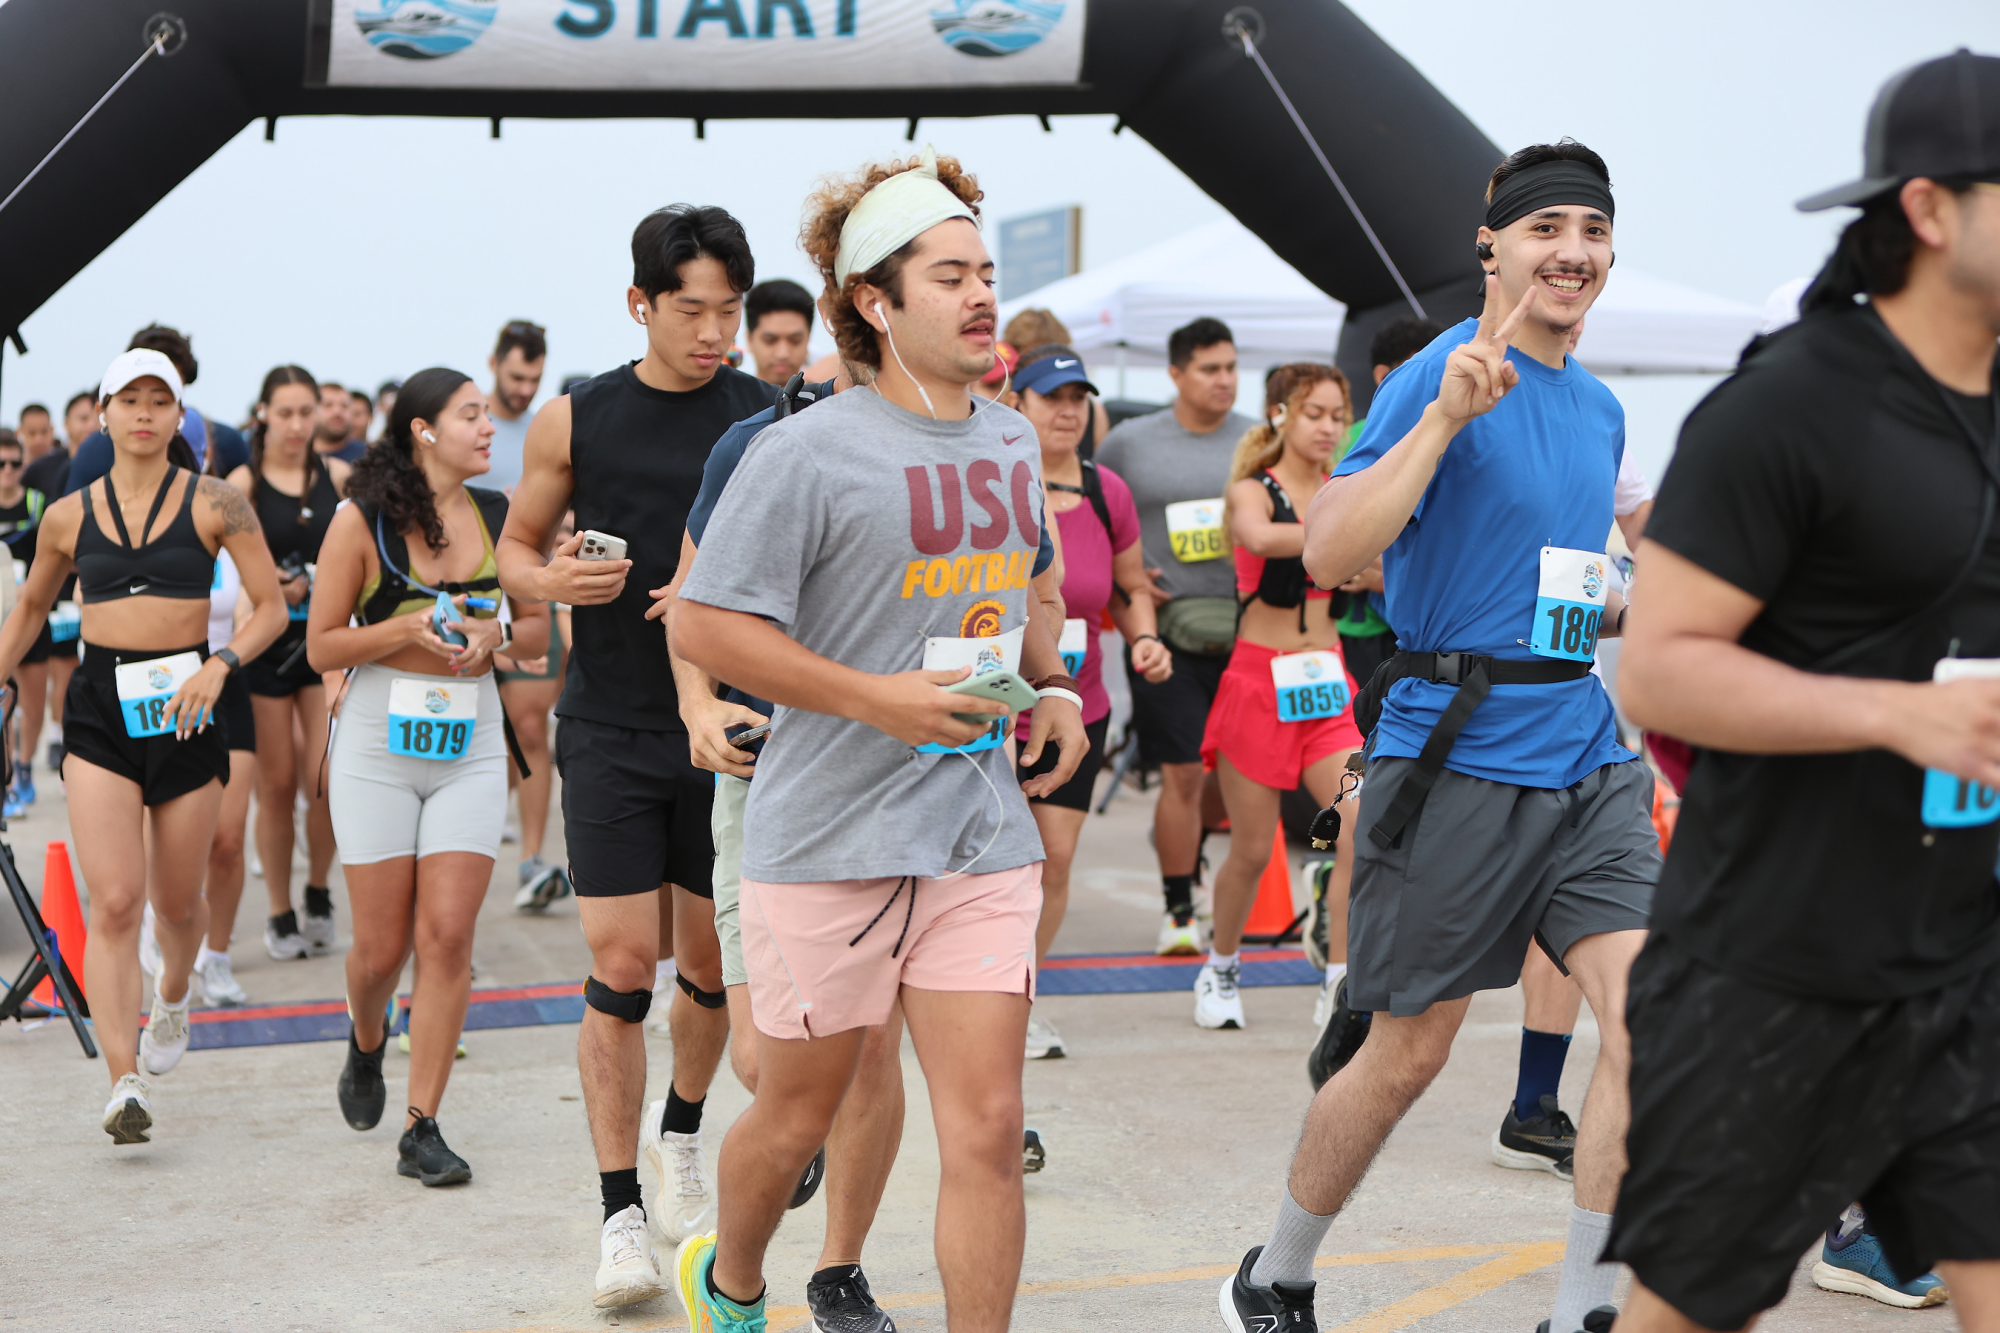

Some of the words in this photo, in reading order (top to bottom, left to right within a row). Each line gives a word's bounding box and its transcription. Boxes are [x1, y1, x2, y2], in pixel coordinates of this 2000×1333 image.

[903, 459, 1038, 555] USC
[1286, 684, 1345, 715] 1859
[398, 719, 467, 754] 1879
